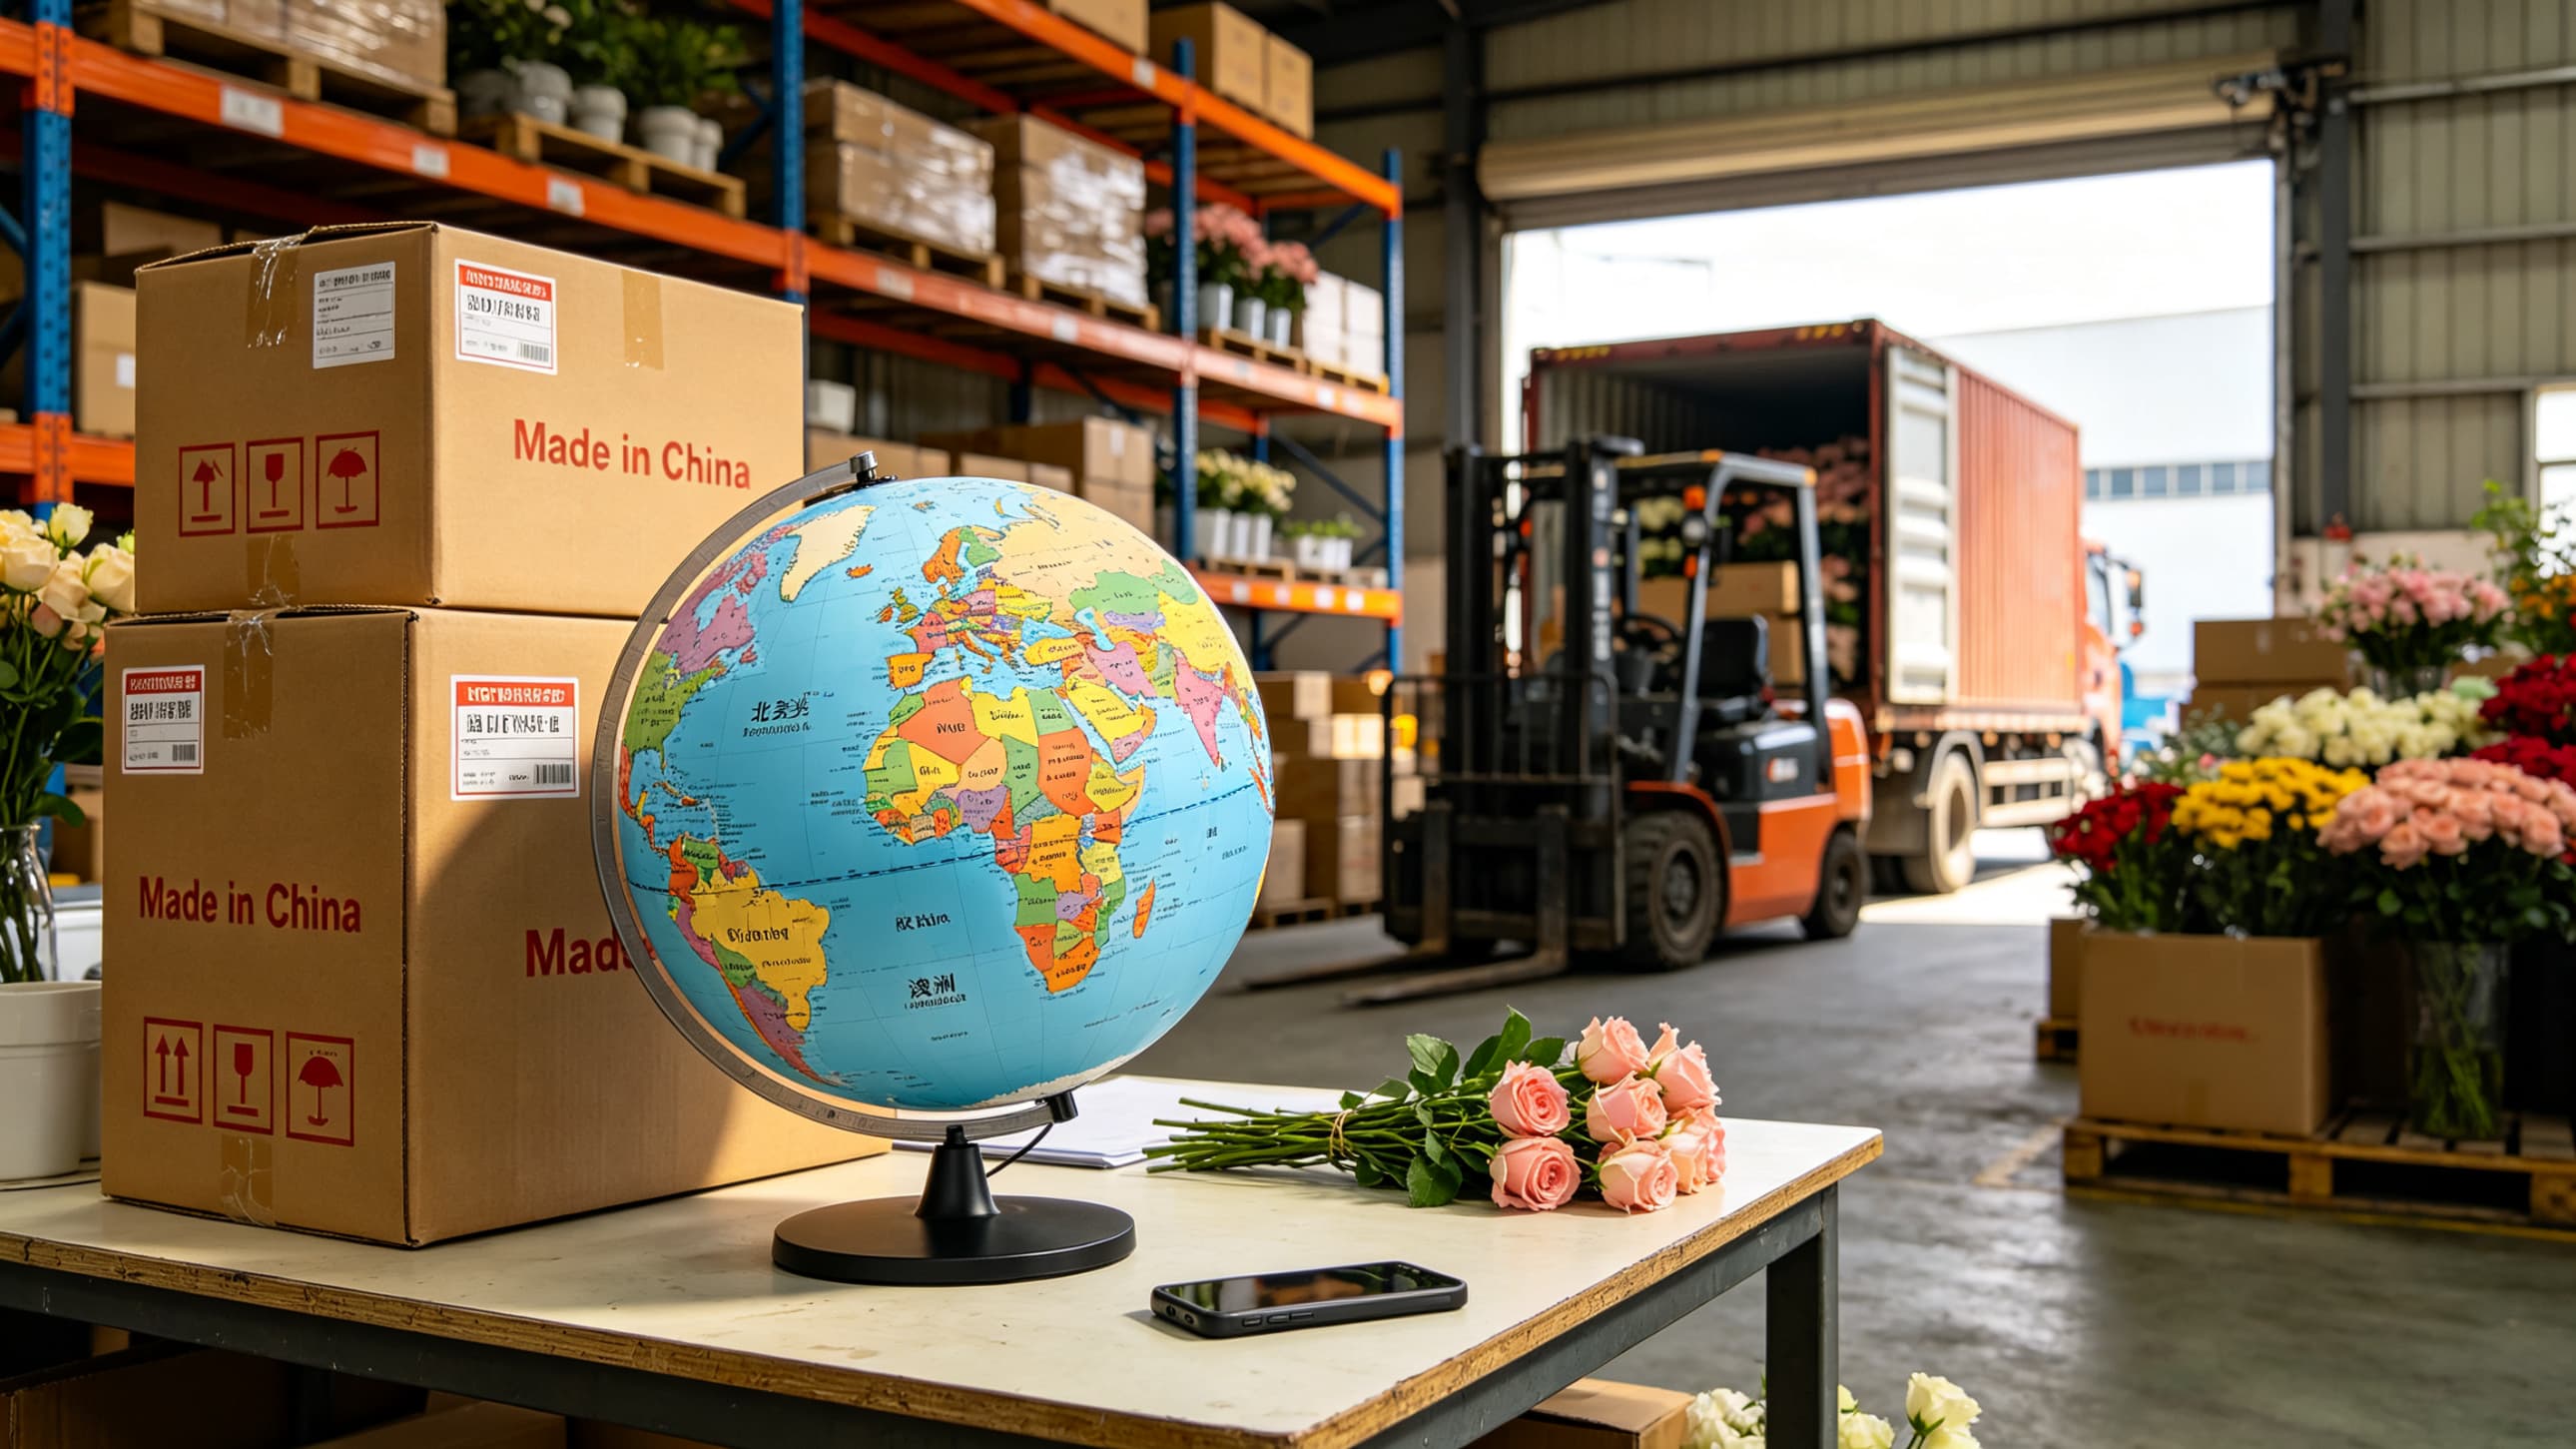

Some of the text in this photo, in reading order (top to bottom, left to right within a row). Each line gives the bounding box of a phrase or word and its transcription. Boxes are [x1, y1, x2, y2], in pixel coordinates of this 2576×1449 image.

[514, 418, 751, 489] Made in China
[140, 876, 360, 933] Made in China
